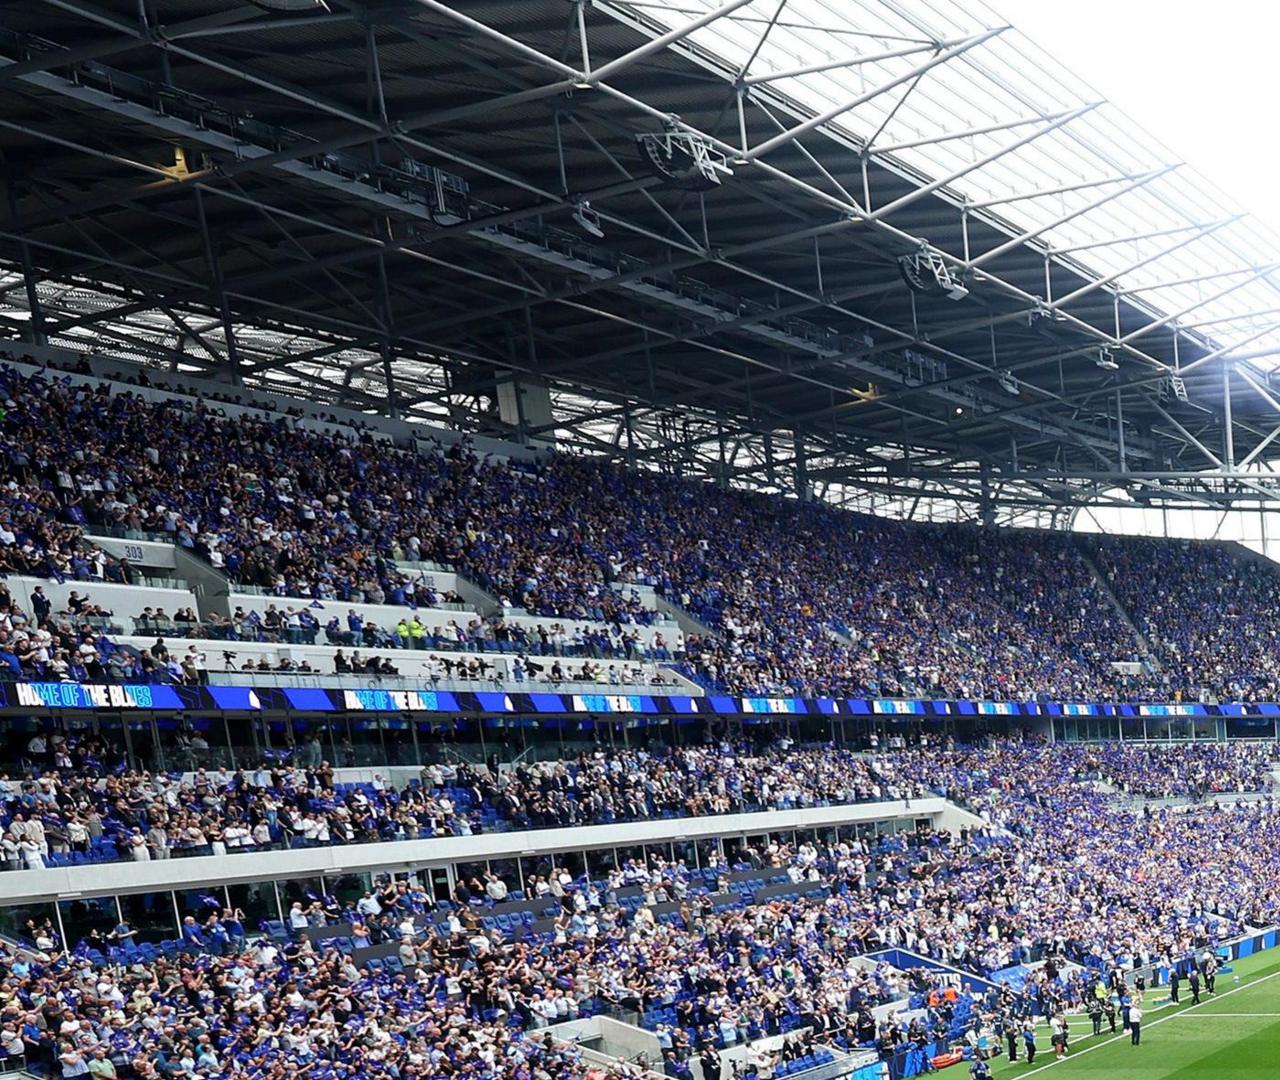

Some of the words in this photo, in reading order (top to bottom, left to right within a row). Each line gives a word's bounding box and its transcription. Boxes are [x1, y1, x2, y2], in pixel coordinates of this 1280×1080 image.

[16, 683, 61, 706] HOME
[61, 684, 79, 706] OF
[80, 684, 110, 707] THE
[110, 685, 151, 708] BLUES
